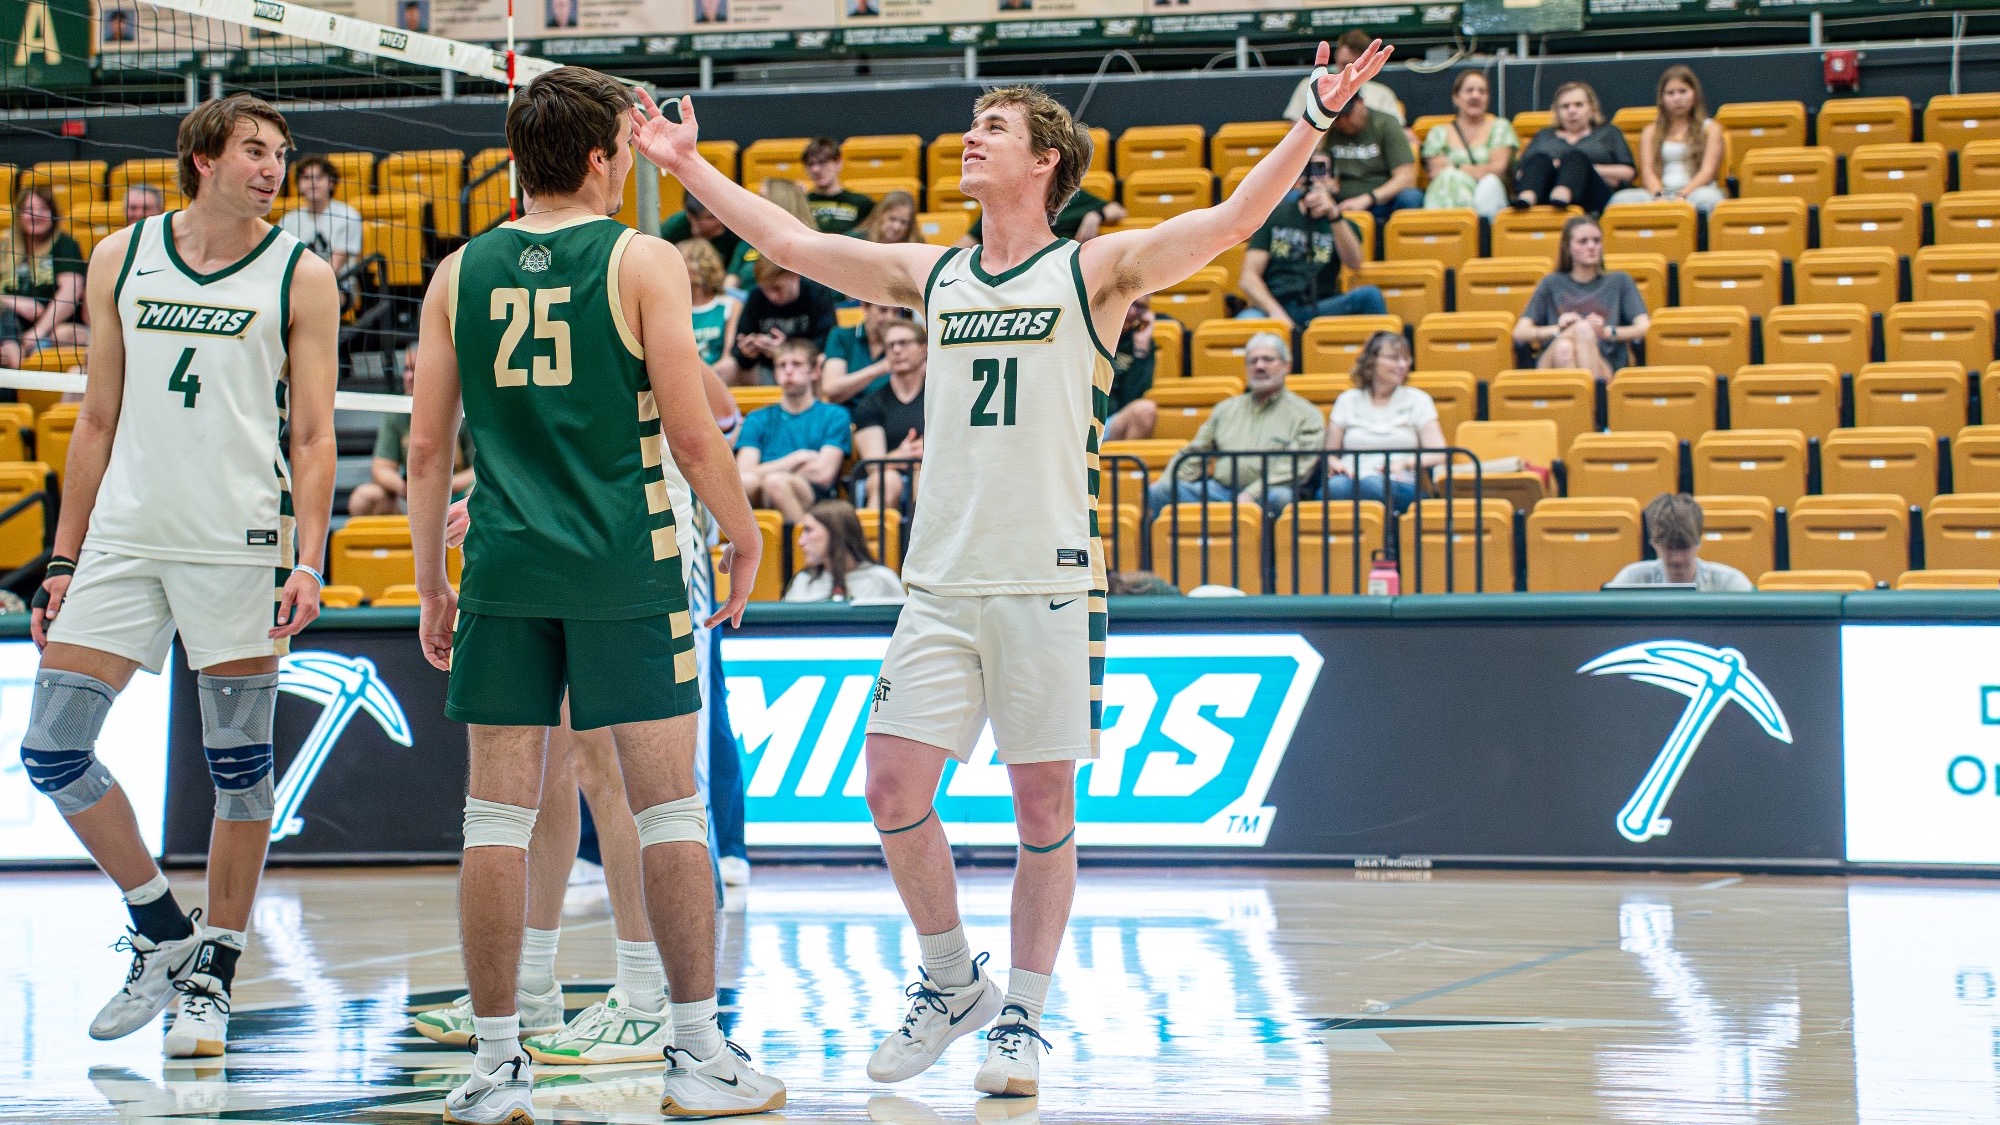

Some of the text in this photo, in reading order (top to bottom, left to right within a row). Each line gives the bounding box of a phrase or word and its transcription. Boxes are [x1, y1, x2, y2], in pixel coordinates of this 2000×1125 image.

[14, 0, 62, 66] A
[141, 303, 249, 332] MINERS
[490, 286, 573, 388] 25
[943, 311, 1054, 340] MINERS
[168, 347, 202, 409] 4
[970, 357, 1018, 427] 21
[725, 673, 1262, 798] MIRS
[1947, 755, 2000, 796] O
[1226, 815, 1261, 834] TM
